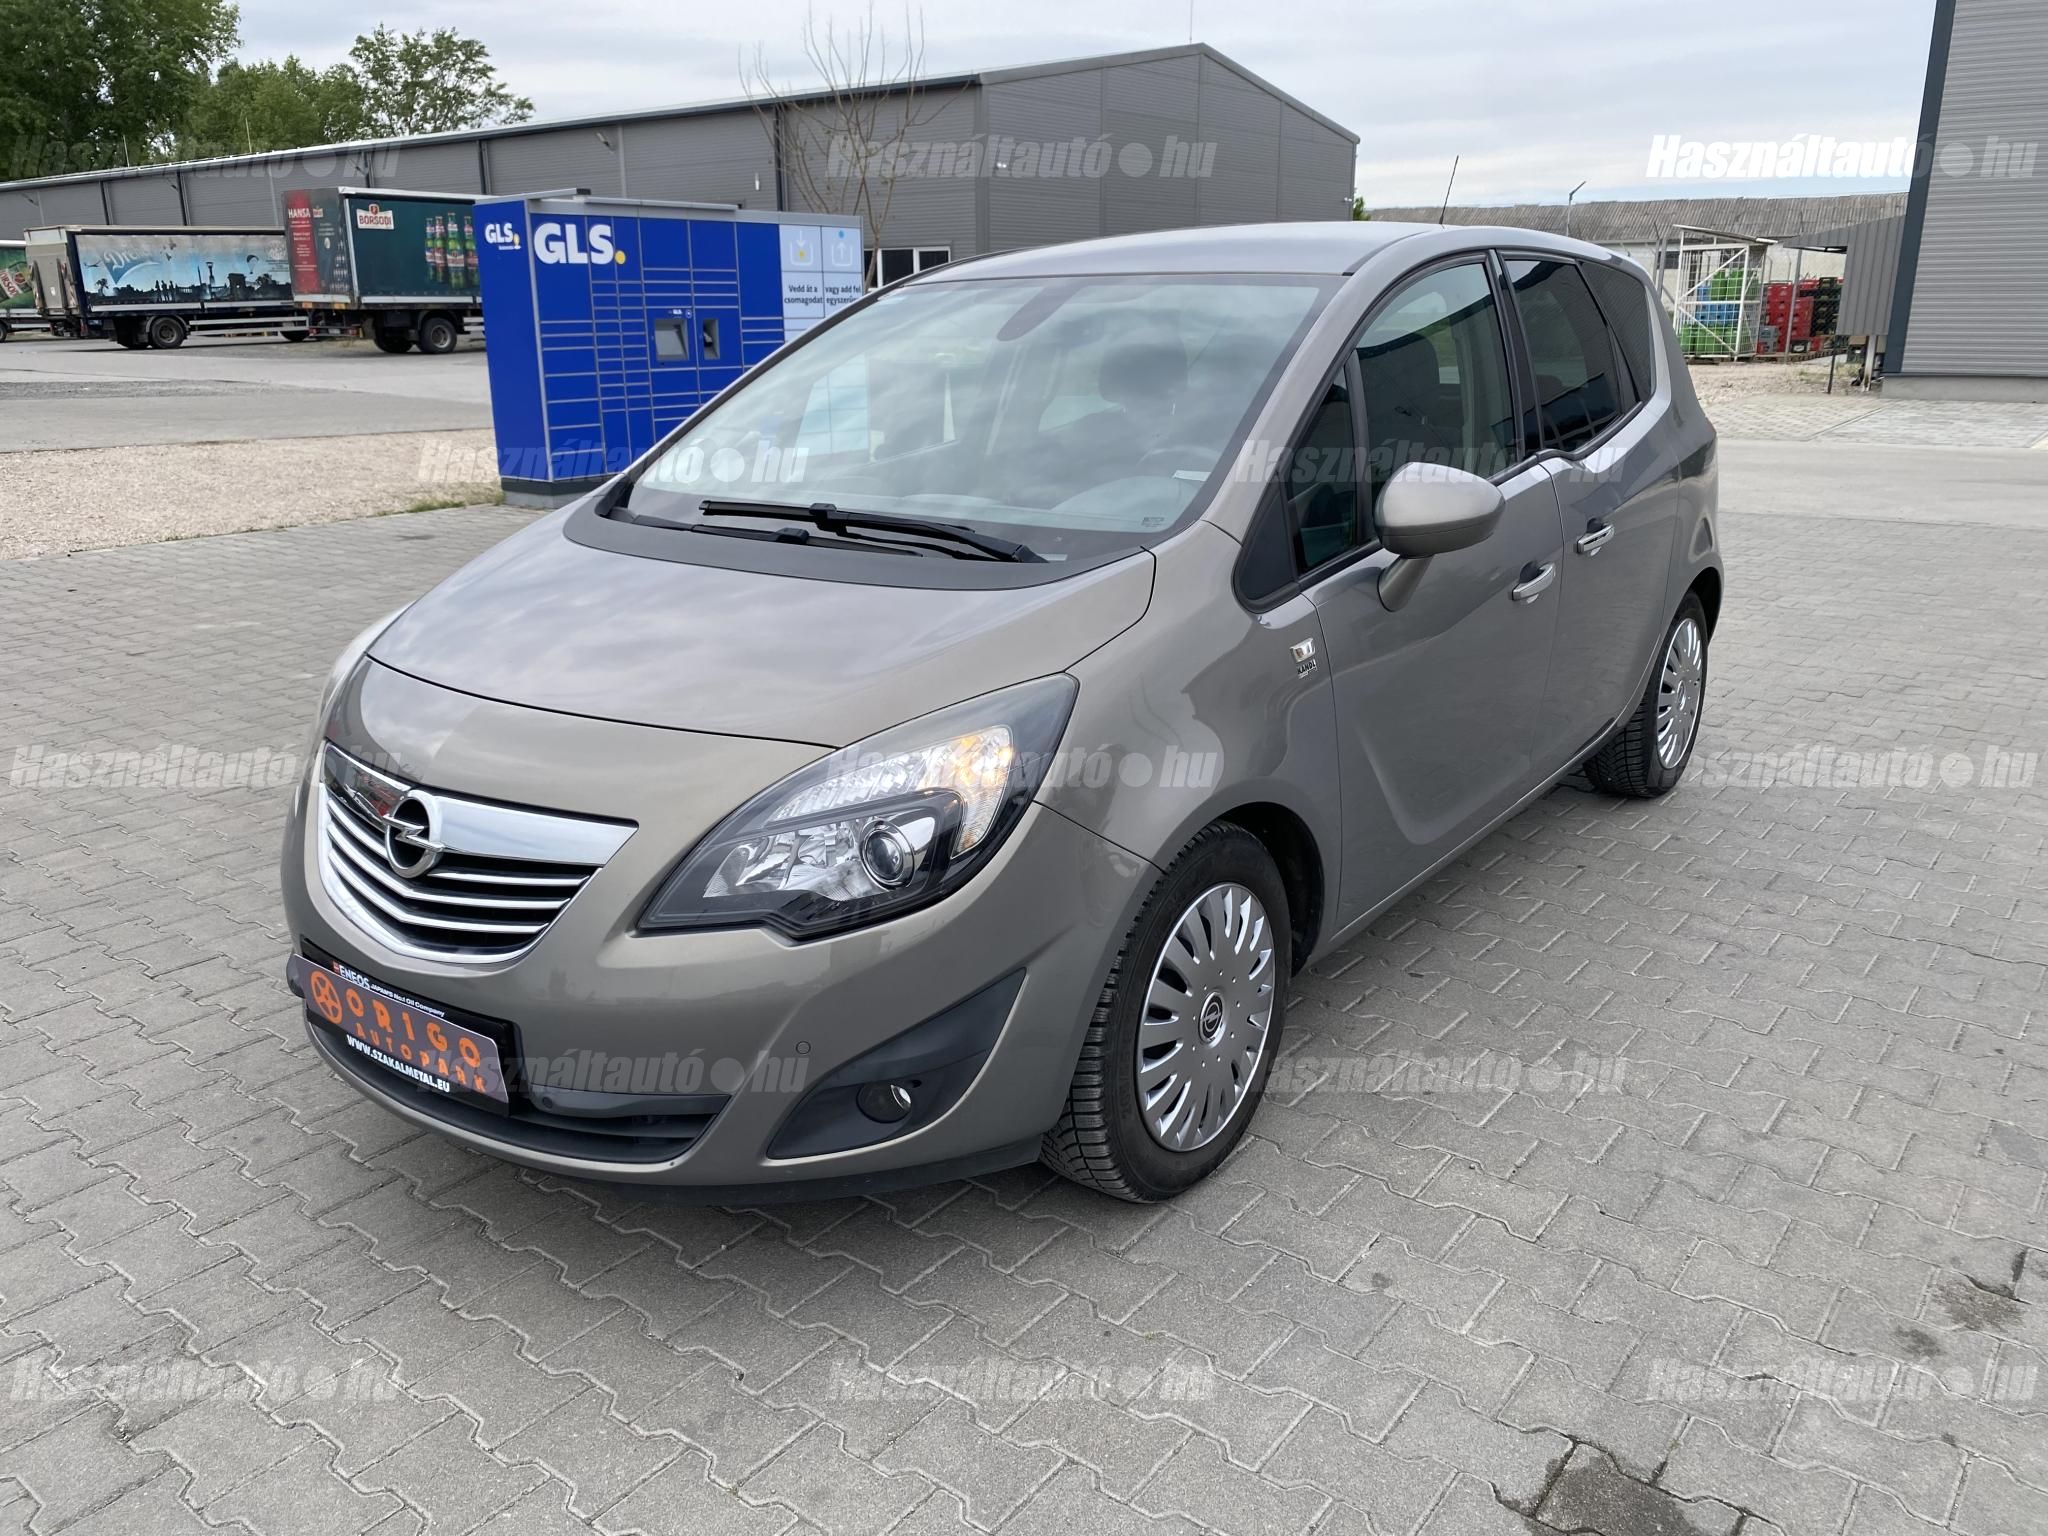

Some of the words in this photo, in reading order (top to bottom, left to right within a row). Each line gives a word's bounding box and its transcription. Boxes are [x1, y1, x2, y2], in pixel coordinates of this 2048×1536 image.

[288, 208, 311, 219] HANSA
[359, 215, 392, 225] BORSODI
[788, 284, 805, 293] Vedd
[806, 284, 813, 293] át
[825, 286, 839, 295] vagy
[841, 285, 852, 293] add
[853, 285, 861, 293] fel
[783, 296, 823, 306] csomagodat
[339, 965, 371, 990] ENEOS
[406, 998, 415, 1006] Oil
[415, 1001, 445, 1018] Company
[345, 988, 481, 1068] ORIGO
[346, 1033, 451, 1093] WWW.SZAKALMETAL.EU
[355, 1022, 486, 1094] AUTOPARK
